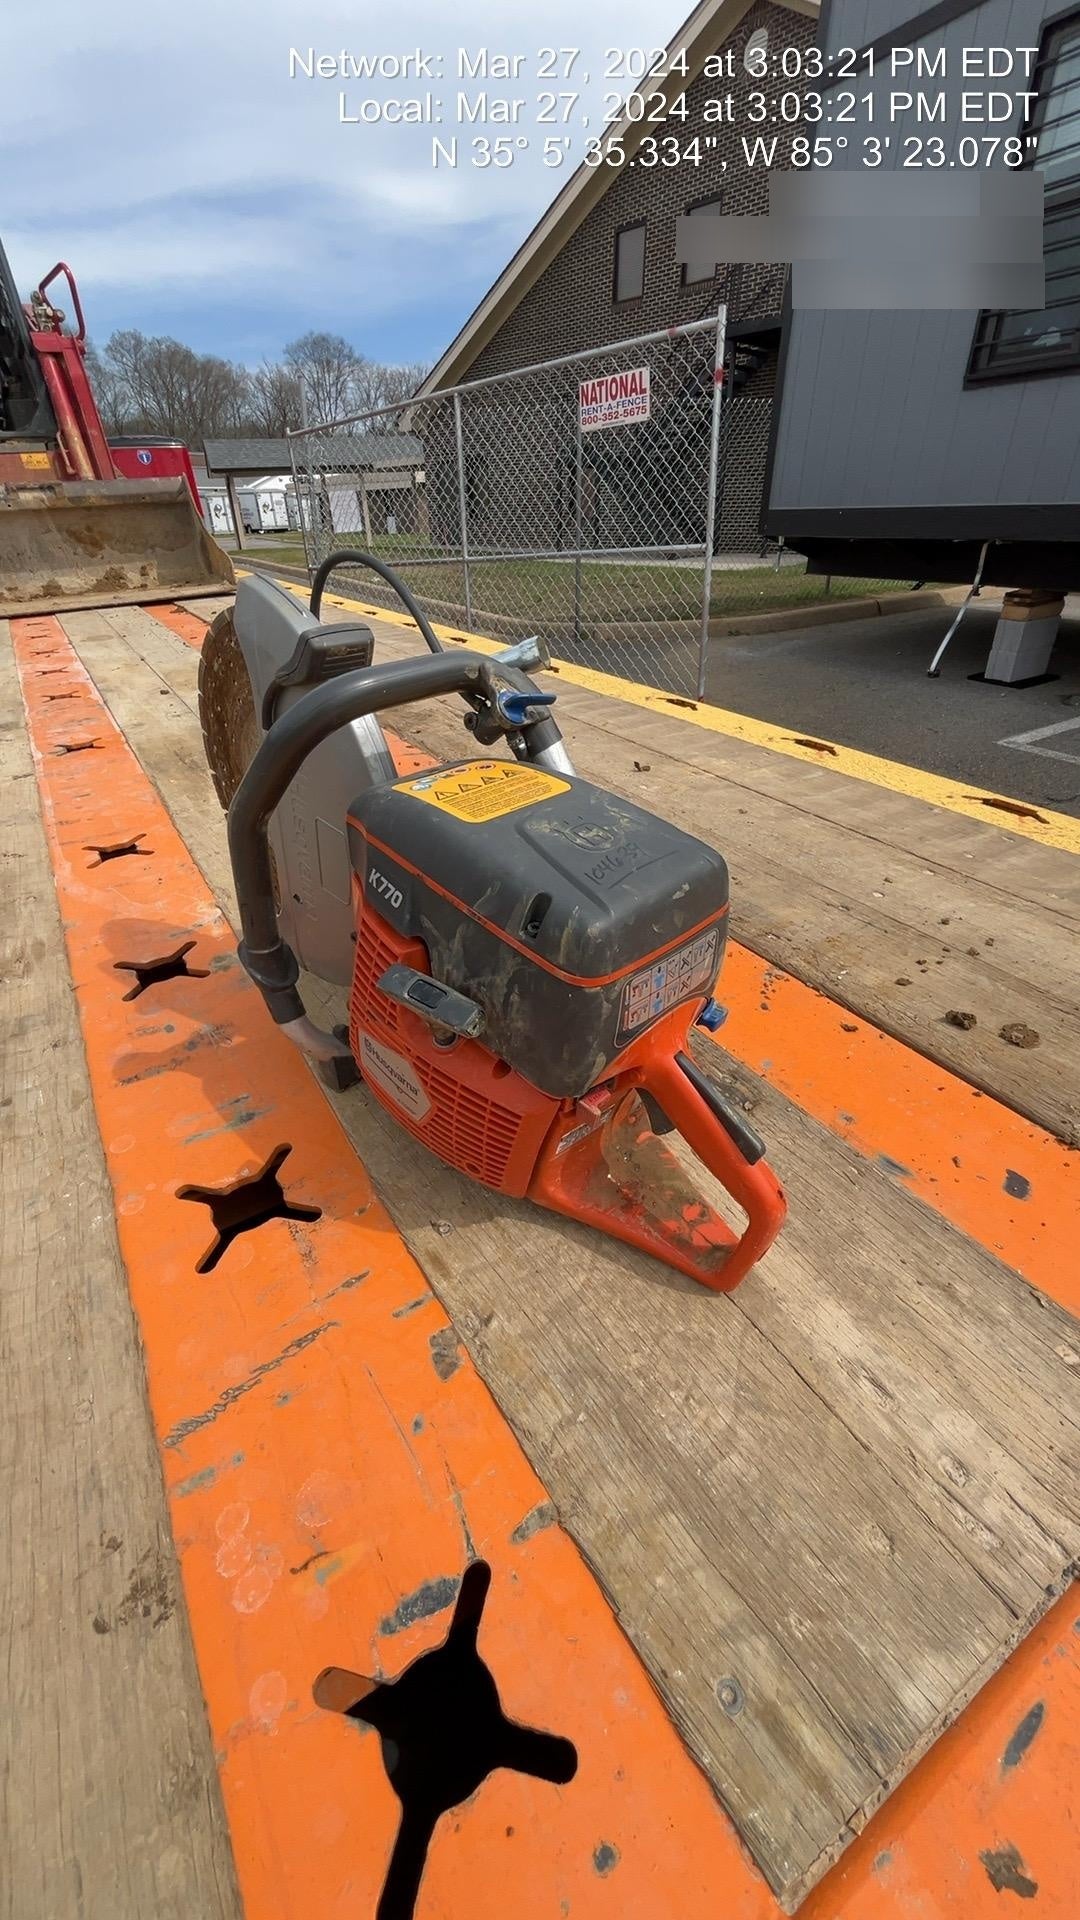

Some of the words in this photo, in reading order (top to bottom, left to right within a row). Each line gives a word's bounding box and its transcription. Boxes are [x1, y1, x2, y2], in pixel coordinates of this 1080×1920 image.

[581, 371, 647, 407] NATIONAL
[581, 395, 648, 417] RENT-A-FENCE
[581, 405, 647, 426] 800-352-5675
[369, 868, 403, 908] K770
